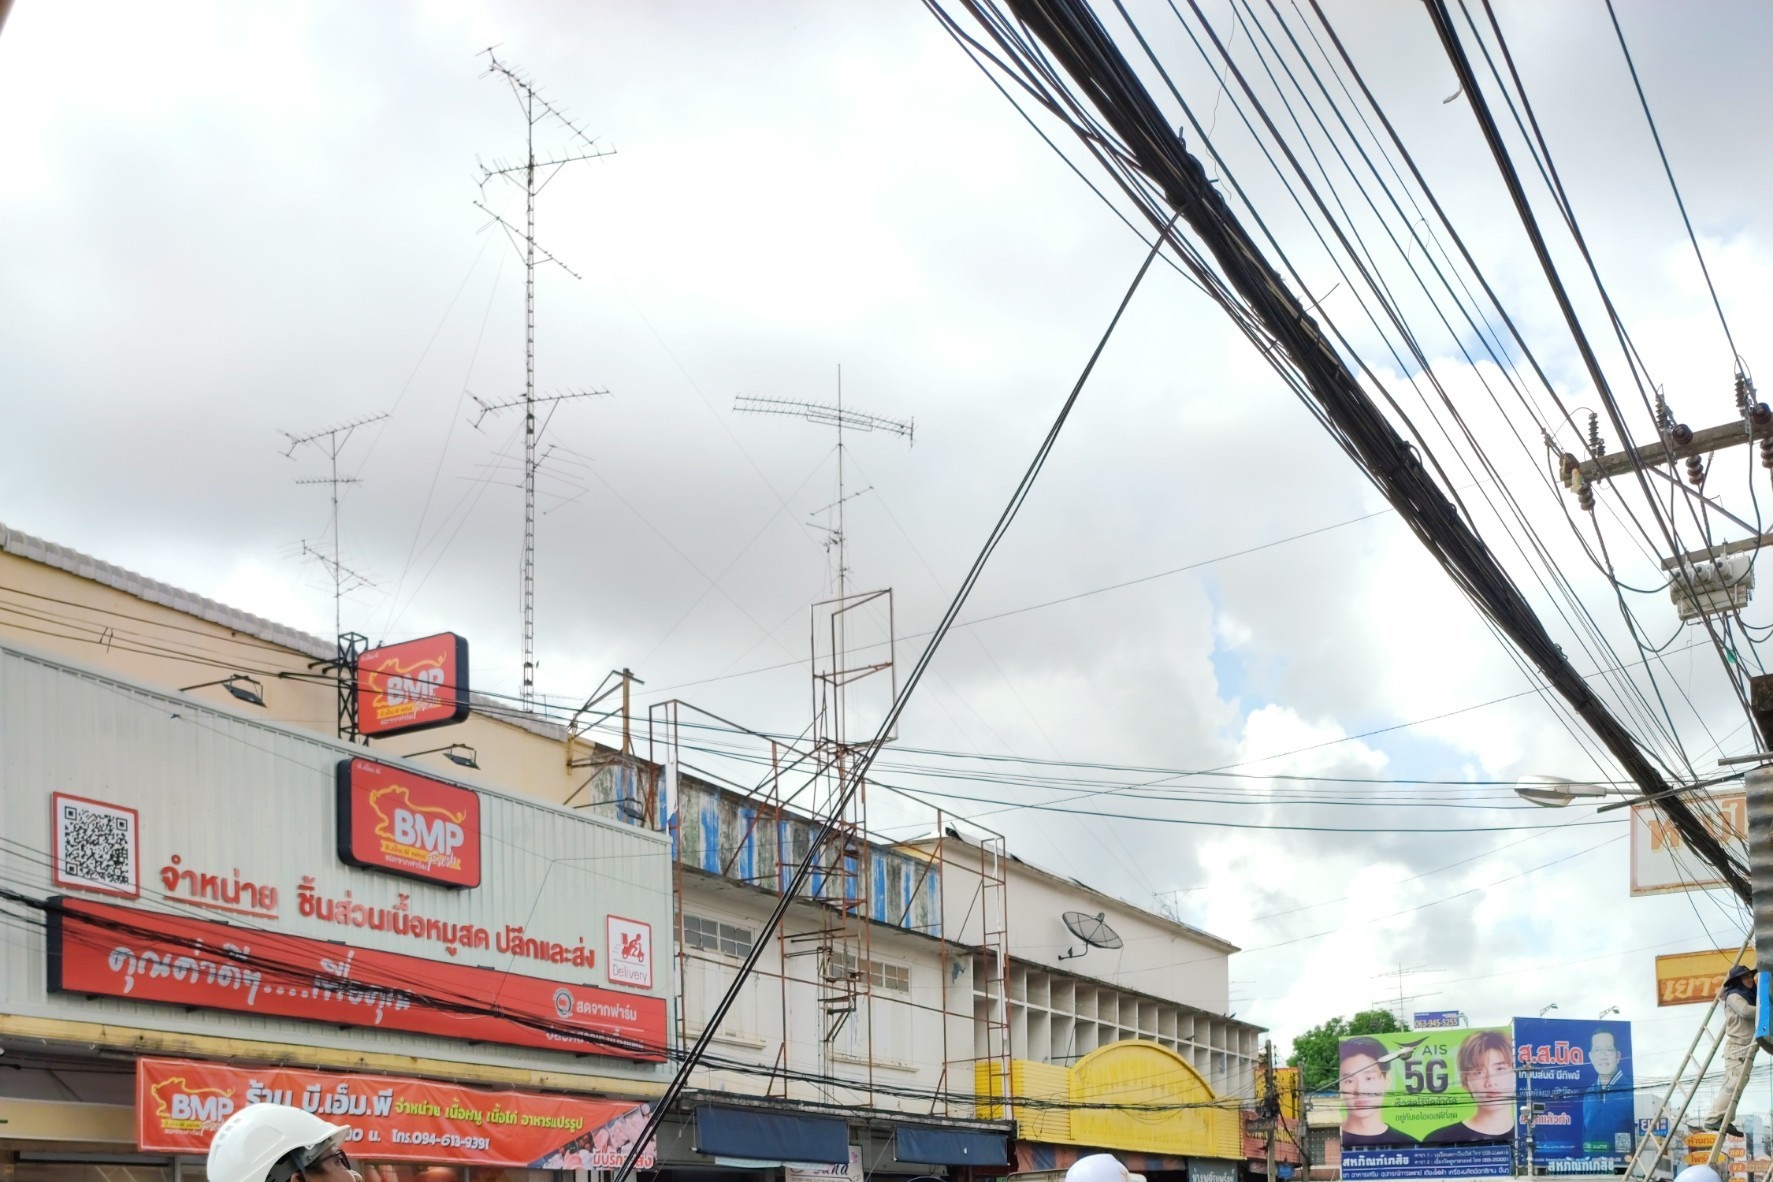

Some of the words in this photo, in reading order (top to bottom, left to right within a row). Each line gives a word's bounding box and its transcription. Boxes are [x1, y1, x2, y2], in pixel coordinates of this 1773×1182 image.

[387, 667, 445, 707] BMP
[394, 808, 465, 856] BMP
[160, 854, 278, 911] จำหน่าย
[495, 924, 595, 970] ปลีกและส่ง
[612, 963, 648, 983] Delivery
[576, 999, 637, 1022] สดจากฟาร์ม
[1422, 1044, 1448, 1056] AIS
[1518, 1041, 1584, 1065] ส.ส.นิด
[1404, 1059, 1448, 1095] 5G
[171, 1093, 234, 1122] BMP
[302, 1083, 394, 1117] บี.เอ็ม.พี
